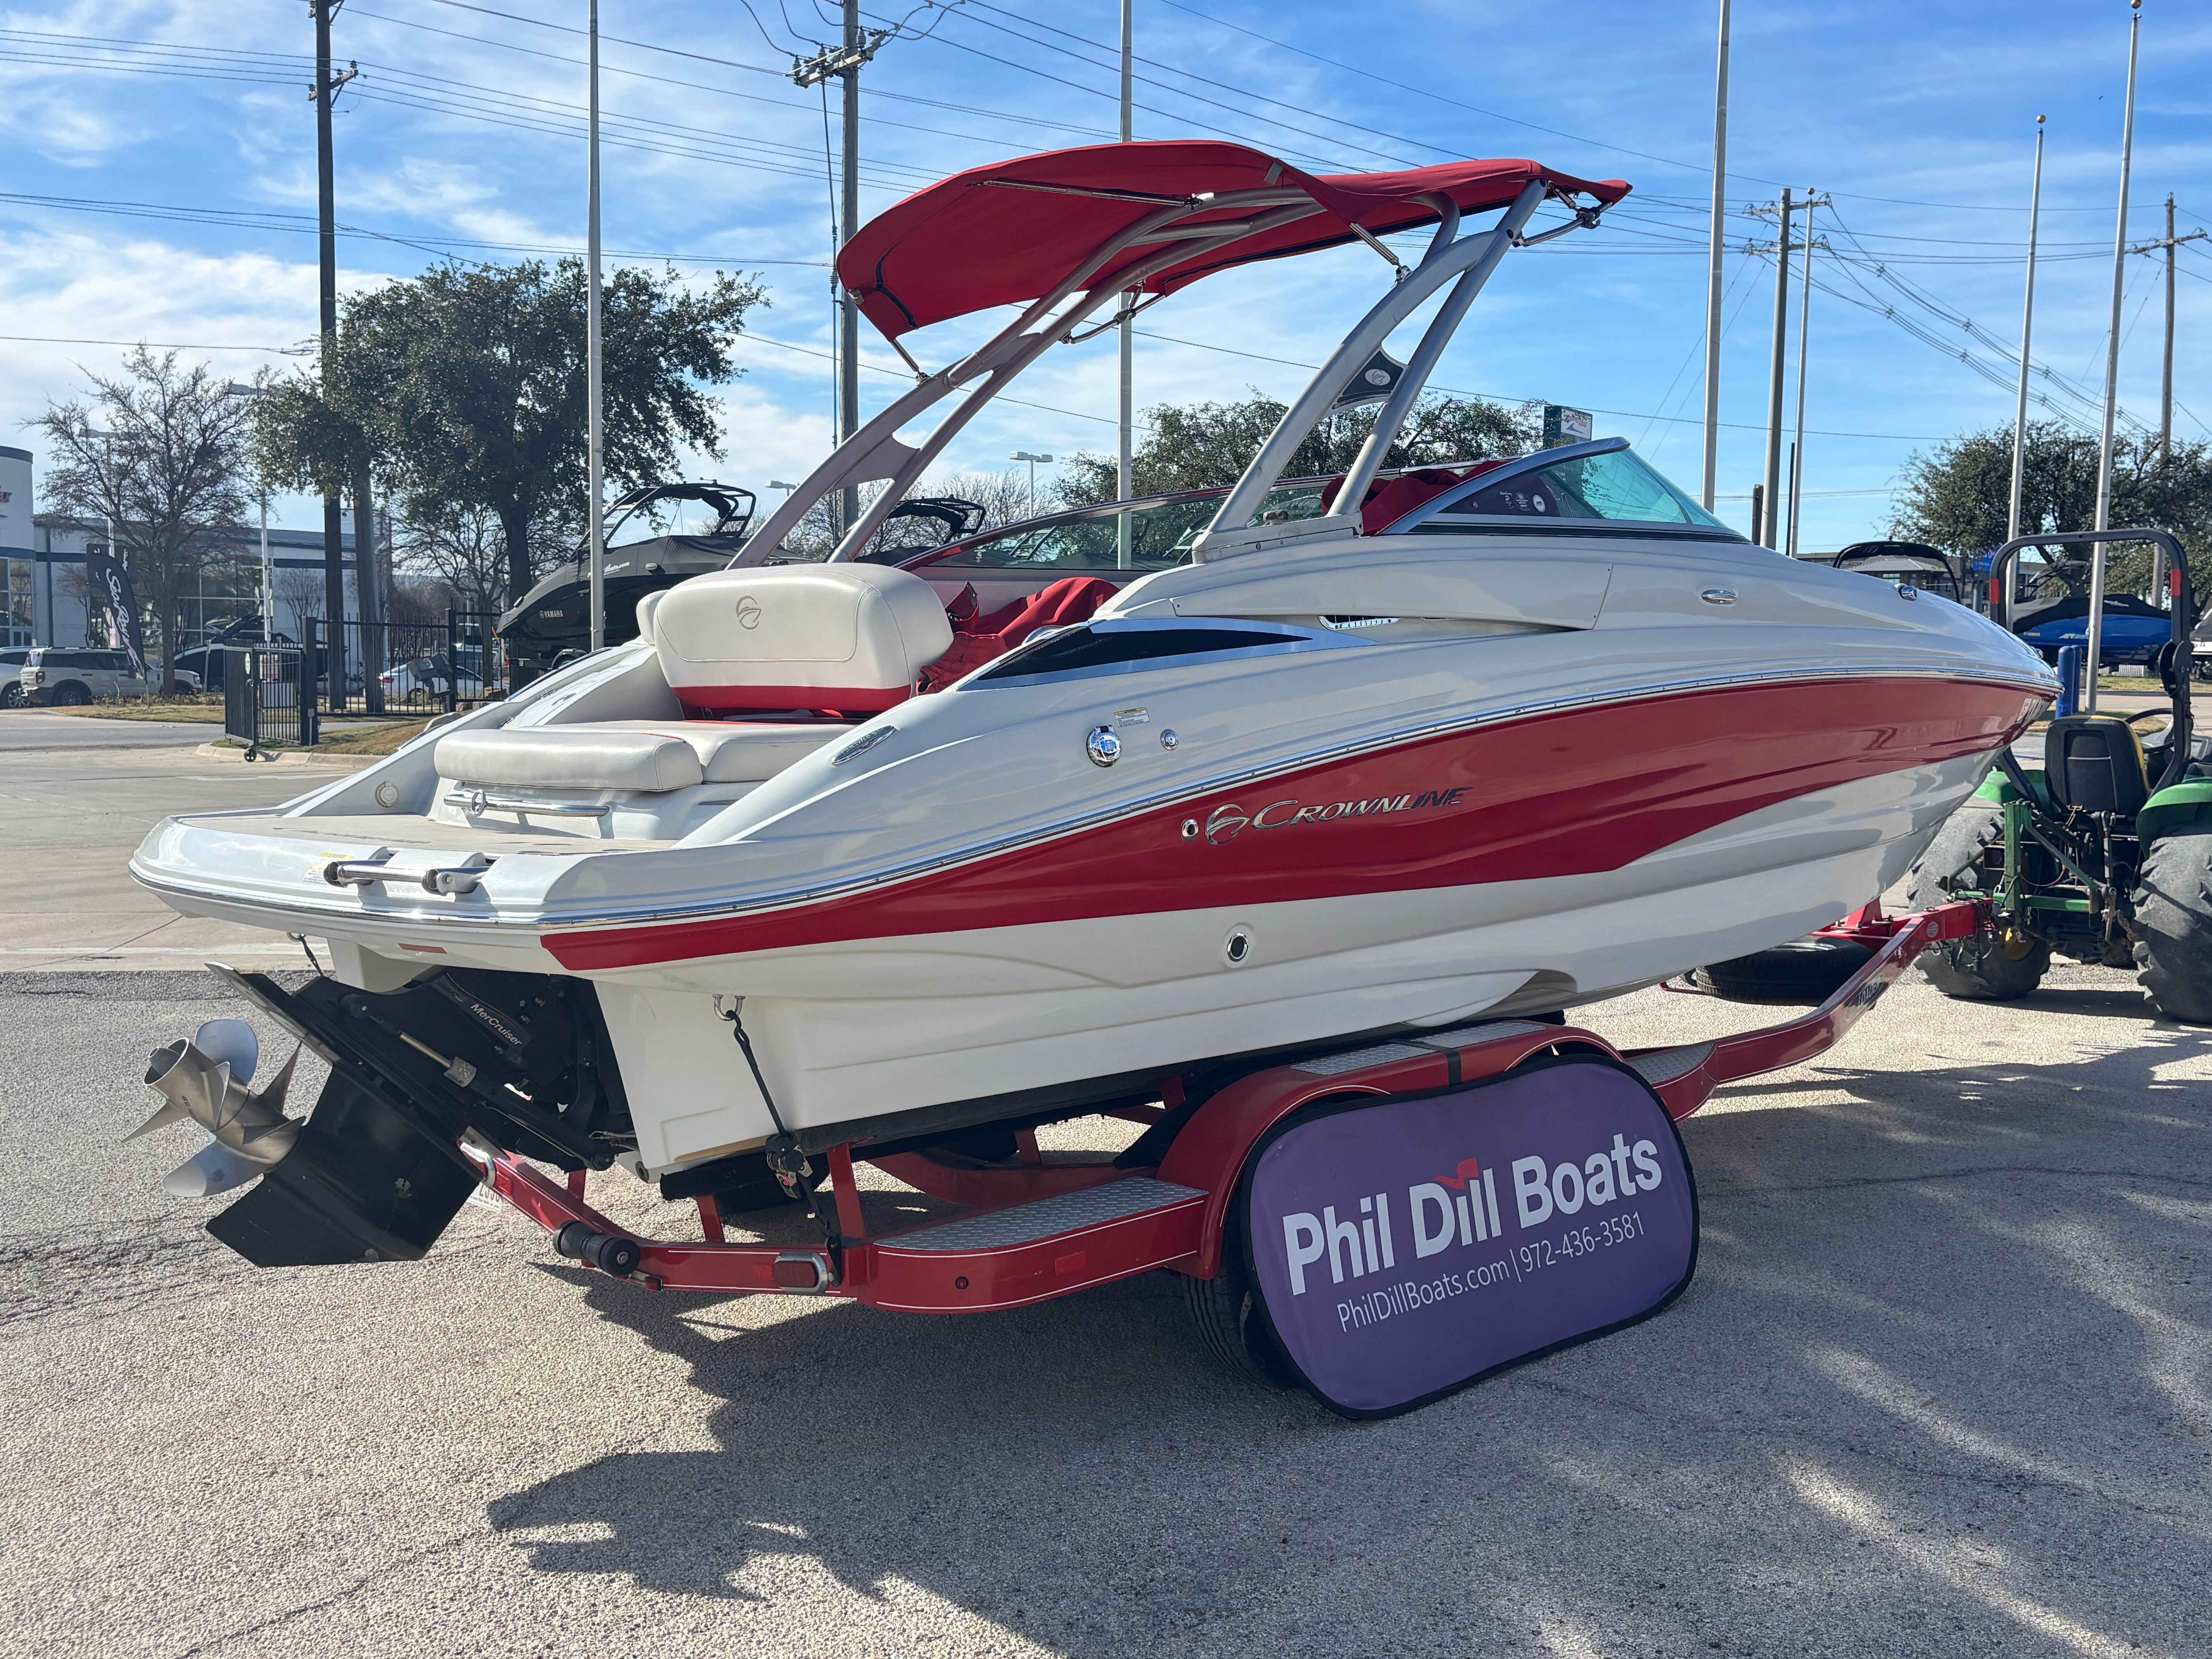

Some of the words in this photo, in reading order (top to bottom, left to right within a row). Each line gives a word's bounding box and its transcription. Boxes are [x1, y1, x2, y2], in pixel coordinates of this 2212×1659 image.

[1251, 787, 1473, 830] CROWNLINE
[470, 1003, 522, 1045] MerCruiser
[1282, 1192, 1395, 1296] Phil
[1409, 1168, 1502, 1259] Dill
[1511, 1133, 1662, 1229] Boats
[1336, 1260, 1510, 1333] PhilDillBoats.com
[1520, 1211, 1644, 1272] 972-436-3581
